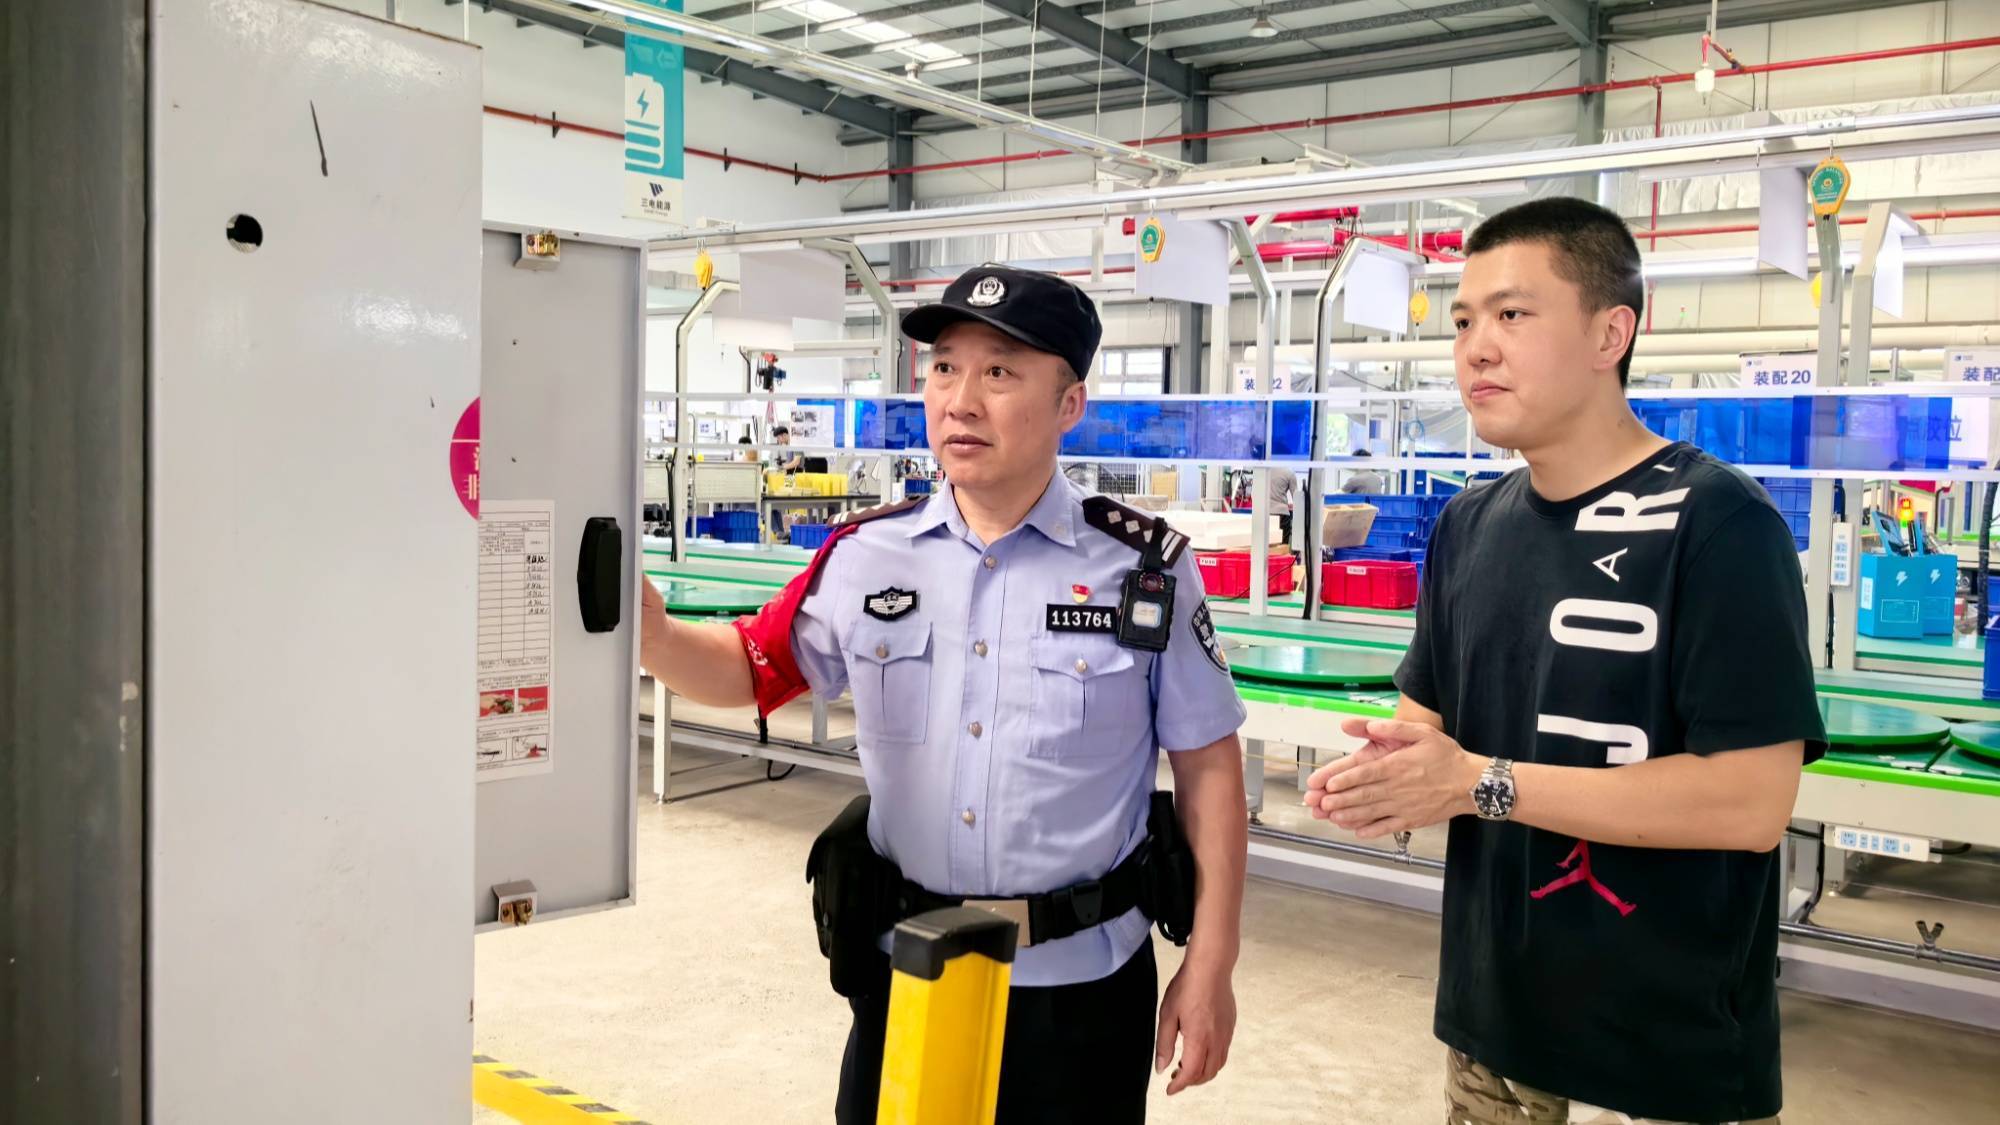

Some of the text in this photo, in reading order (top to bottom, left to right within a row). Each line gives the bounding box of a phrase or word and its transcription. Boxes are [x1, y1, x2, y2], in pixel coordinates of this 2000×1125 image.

[641, 198, 671, 211] 三电能源
[1754, 369, 1811, 386] 装配20
[1052, 609, 1112, 628] 113764
